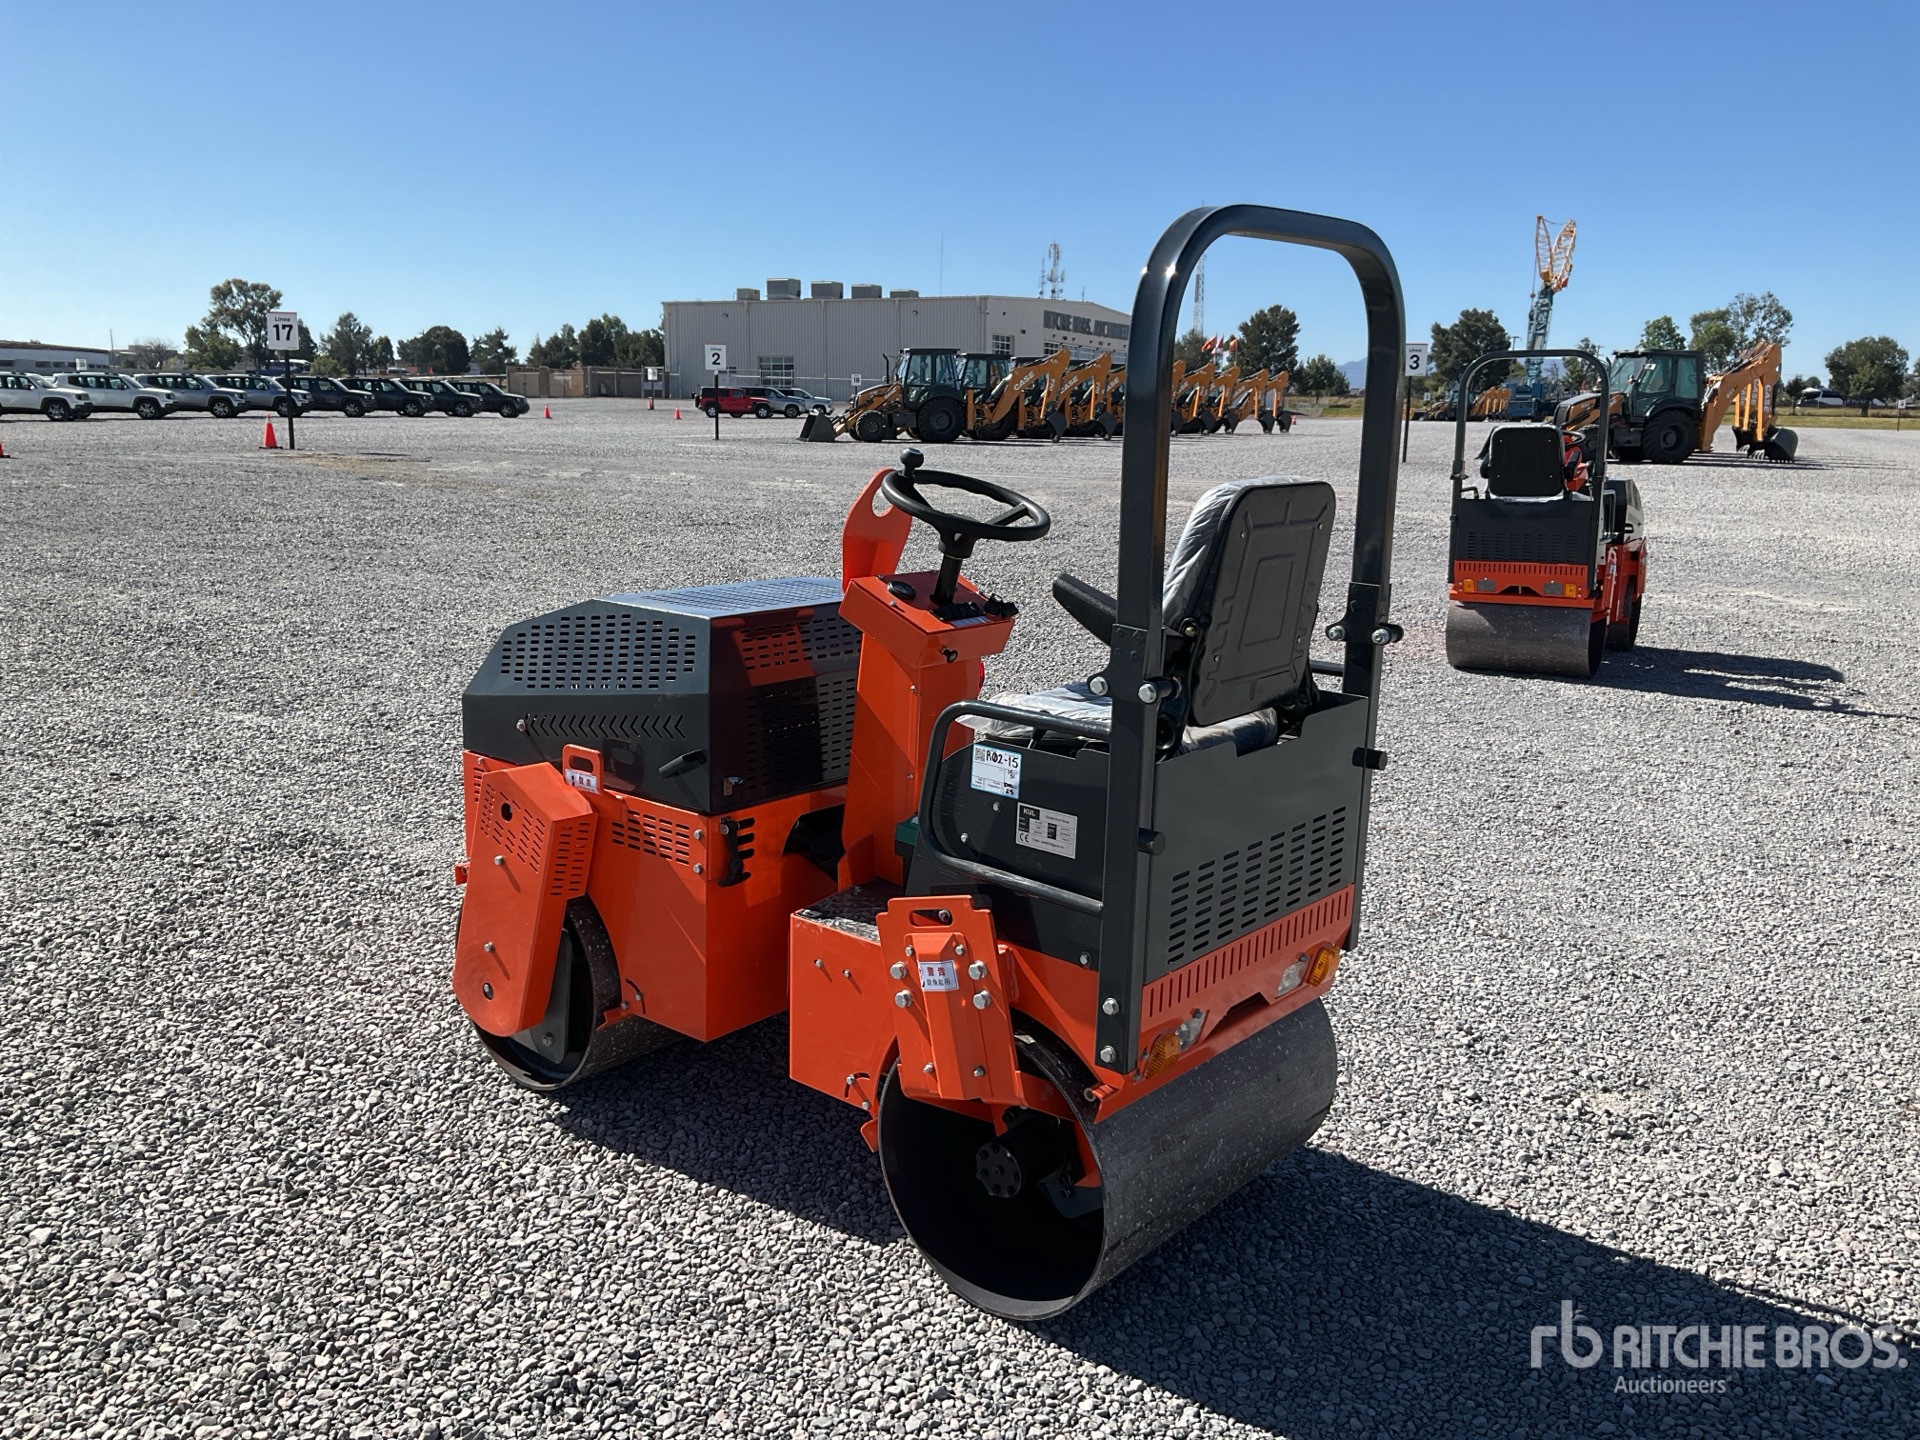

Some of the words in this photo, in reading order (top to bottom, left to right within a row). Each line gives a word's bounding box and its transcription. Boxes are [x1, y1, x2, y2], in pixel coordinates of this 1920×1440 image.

[272, 323, 293, 341] 17
[711, 352, 721, 366] 2
[1409, 354, 1420, 370] 3
[1013, 370, 1035, 391] CASE
[1763, 384, 1771, 412] CASE
[986, 749, 1019, 769] R02-15
[927, 967, 946, 976] 警告
